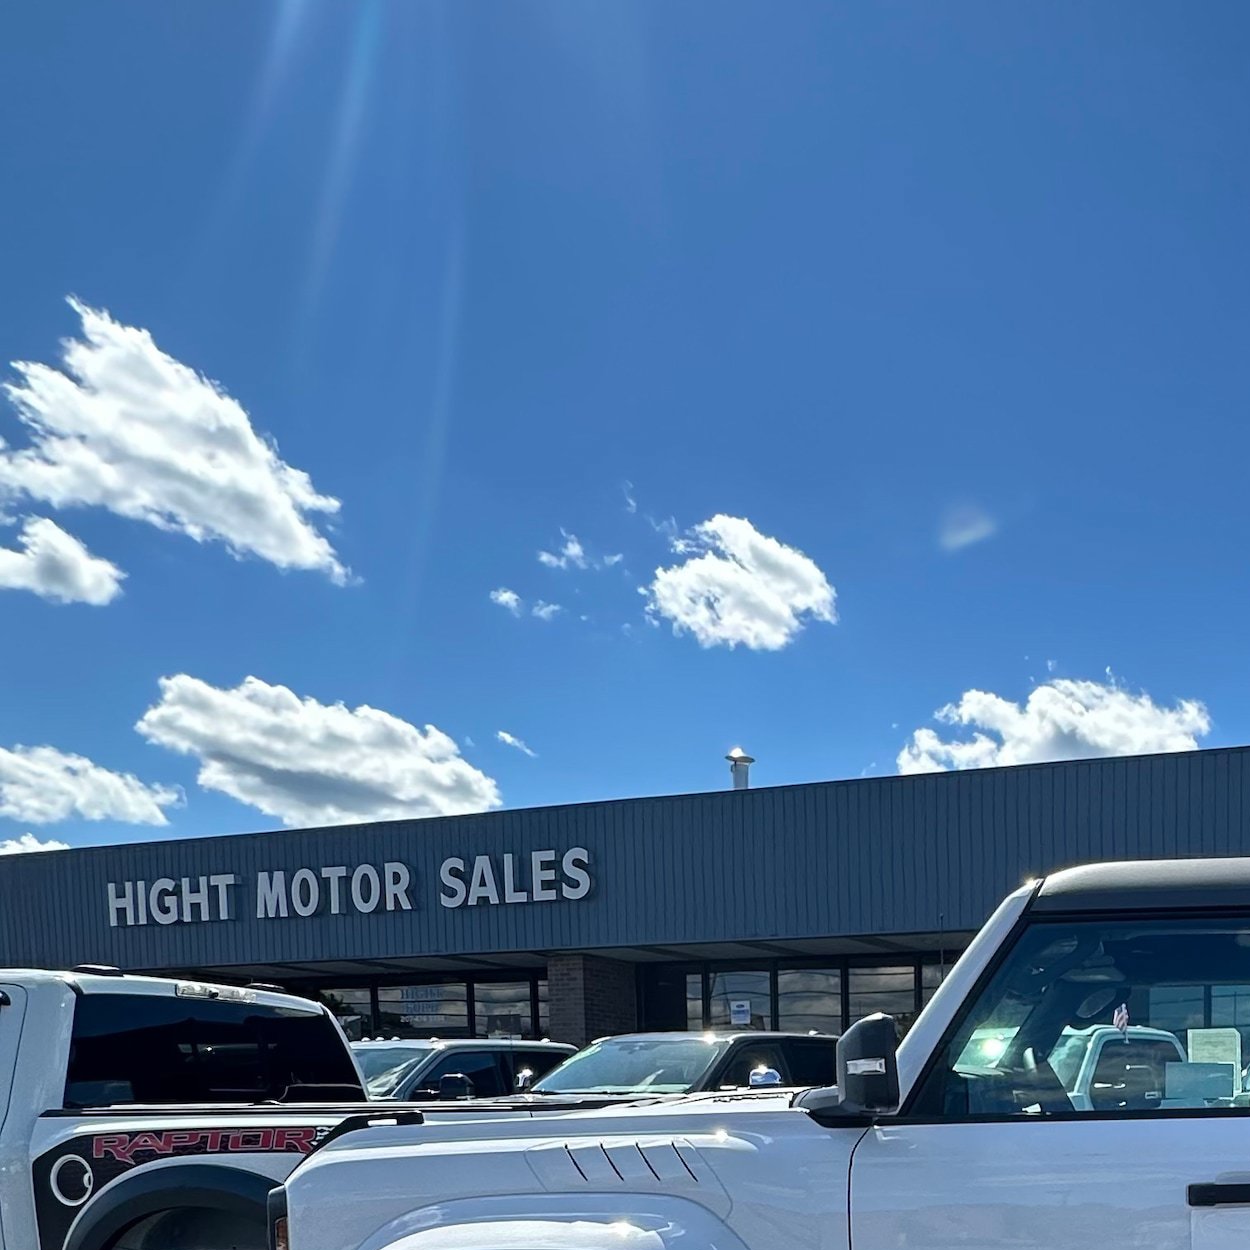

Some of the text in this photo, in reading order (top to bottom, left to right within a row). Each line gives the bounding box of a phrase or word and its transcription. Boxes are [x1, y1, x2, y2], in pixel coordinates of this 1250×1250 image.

[107, 847, 591, 927] HIGHT MOTOR SALES
[93, 1127, 316, 1165] RAPTOR
